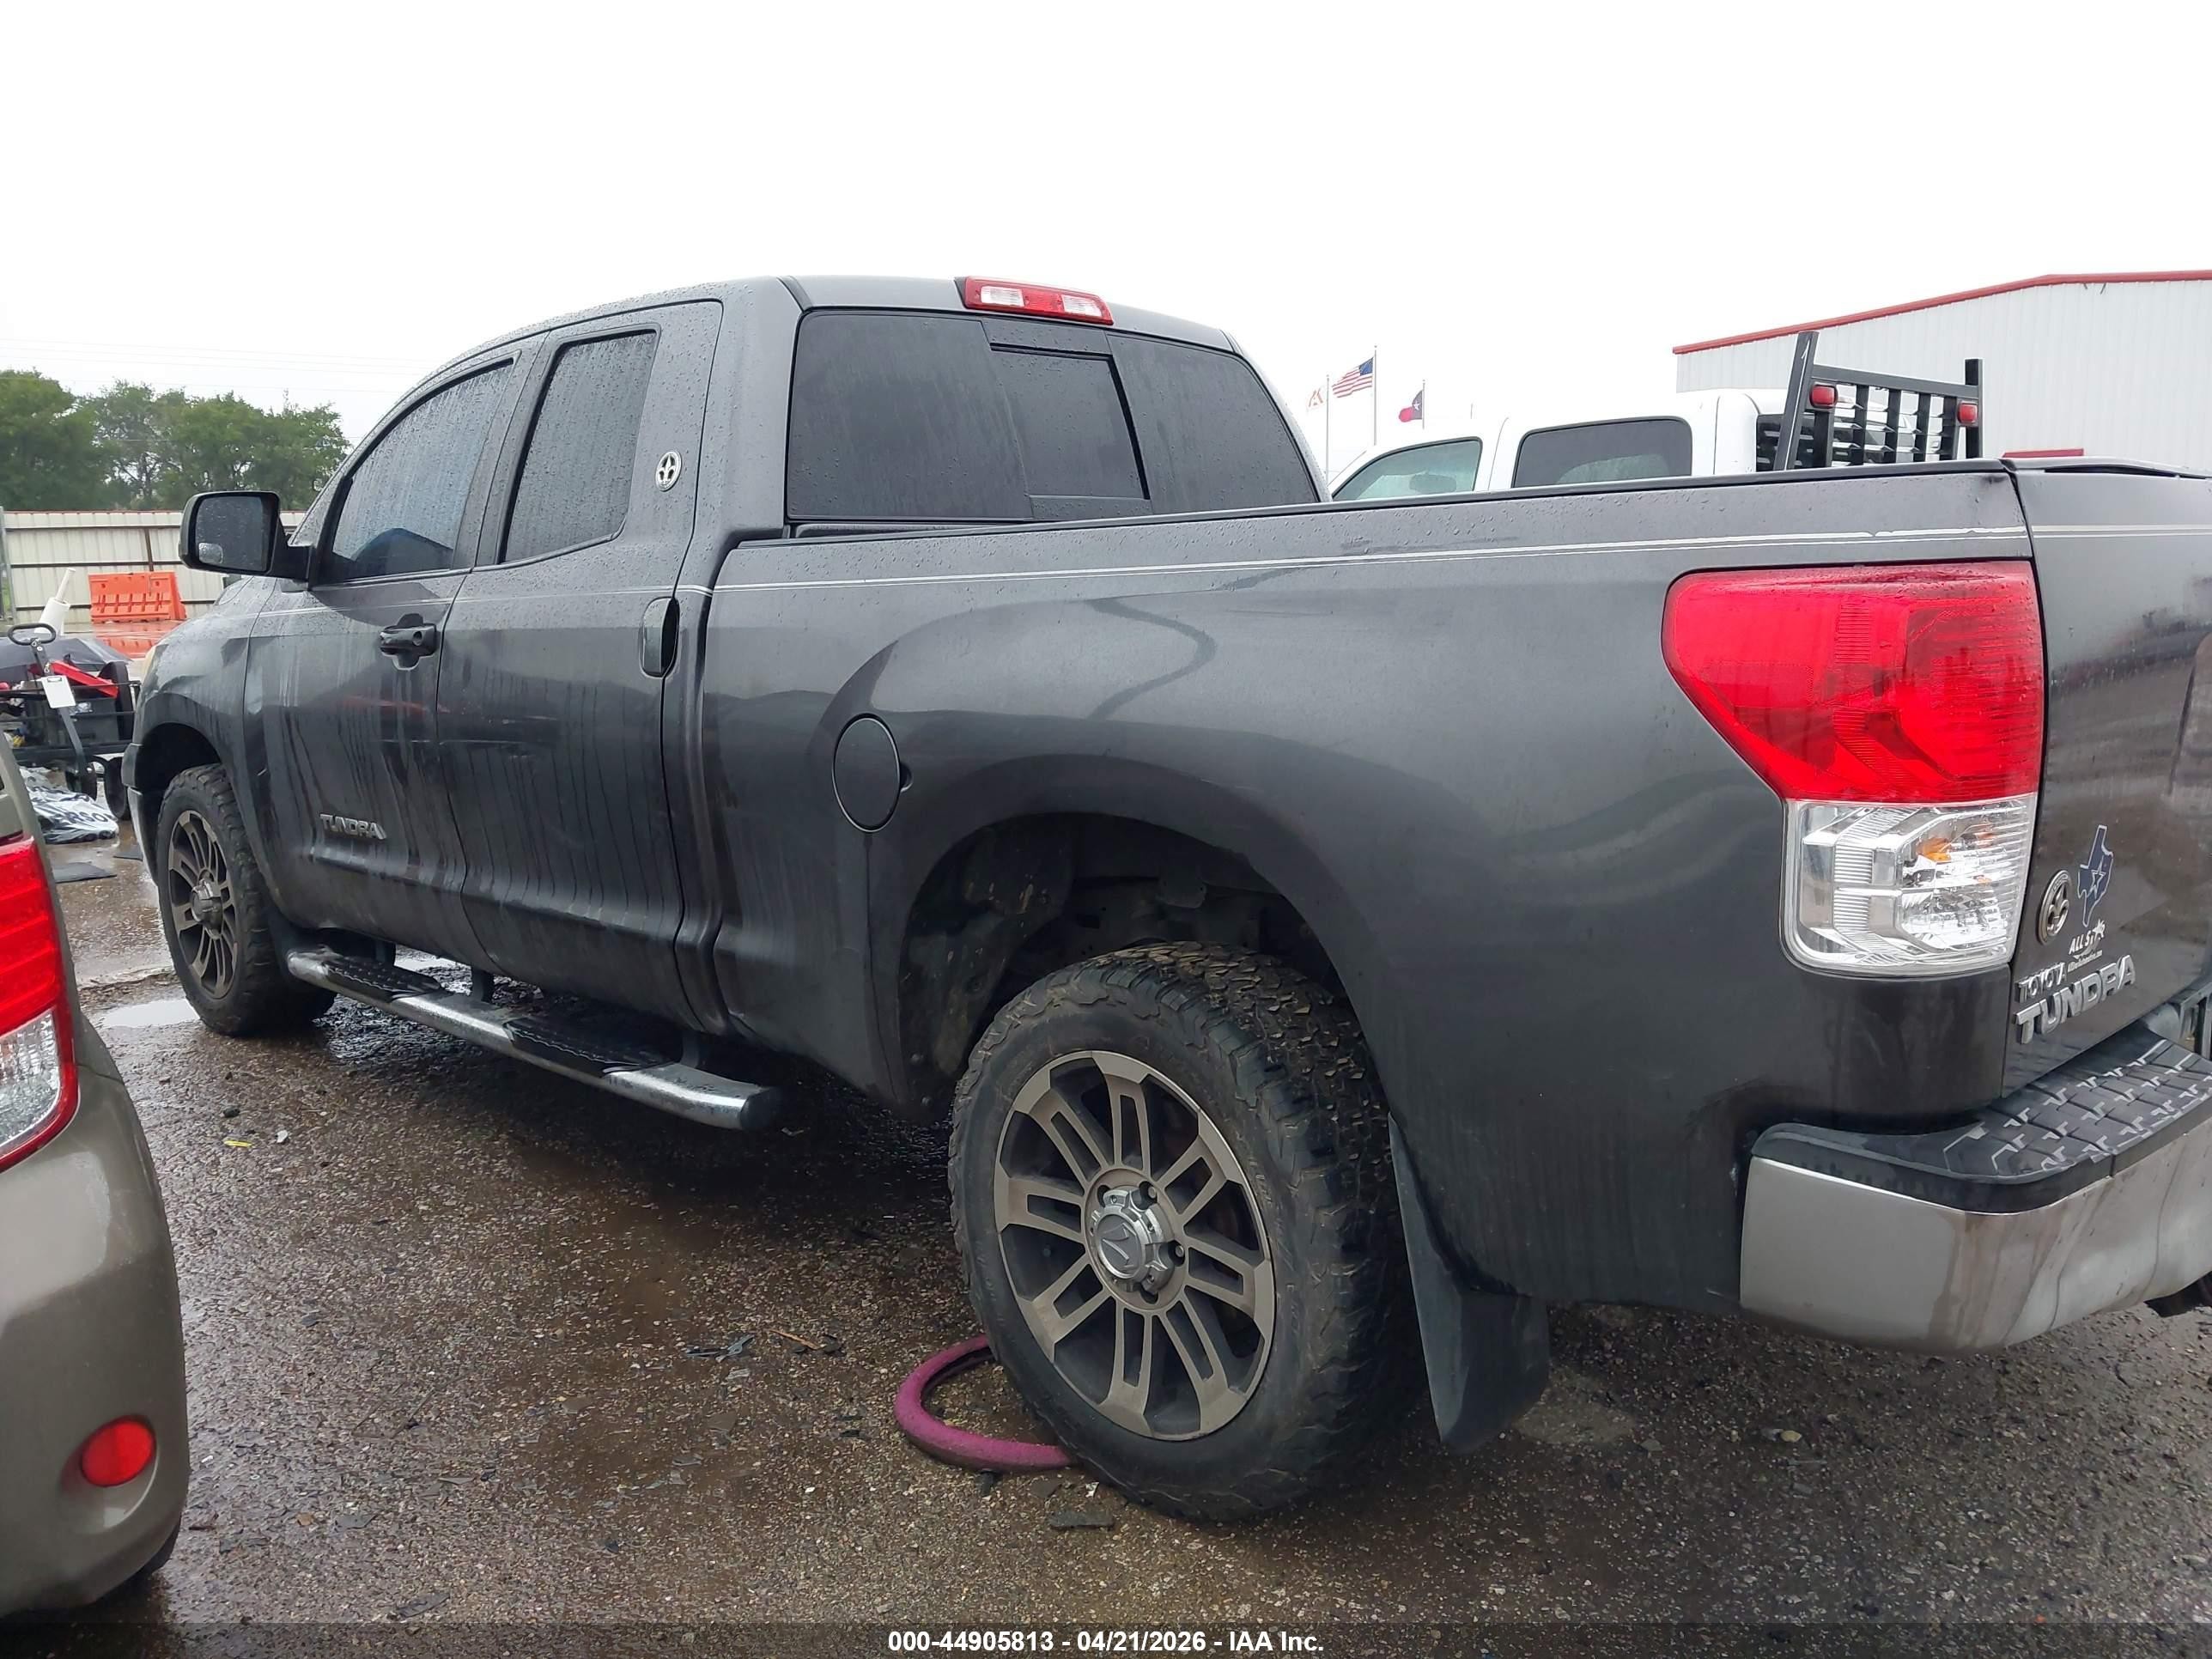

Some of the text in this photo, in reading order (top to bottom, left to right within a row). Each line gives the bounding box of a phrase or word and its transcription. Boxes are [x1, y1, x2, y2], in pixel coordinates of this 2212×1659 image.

[319, 812, 387, 840] TUNDRA
[2014, 953, 2136, 1045] TUNDRA
[2016, 961, 2068, 1004] TOYOTA
